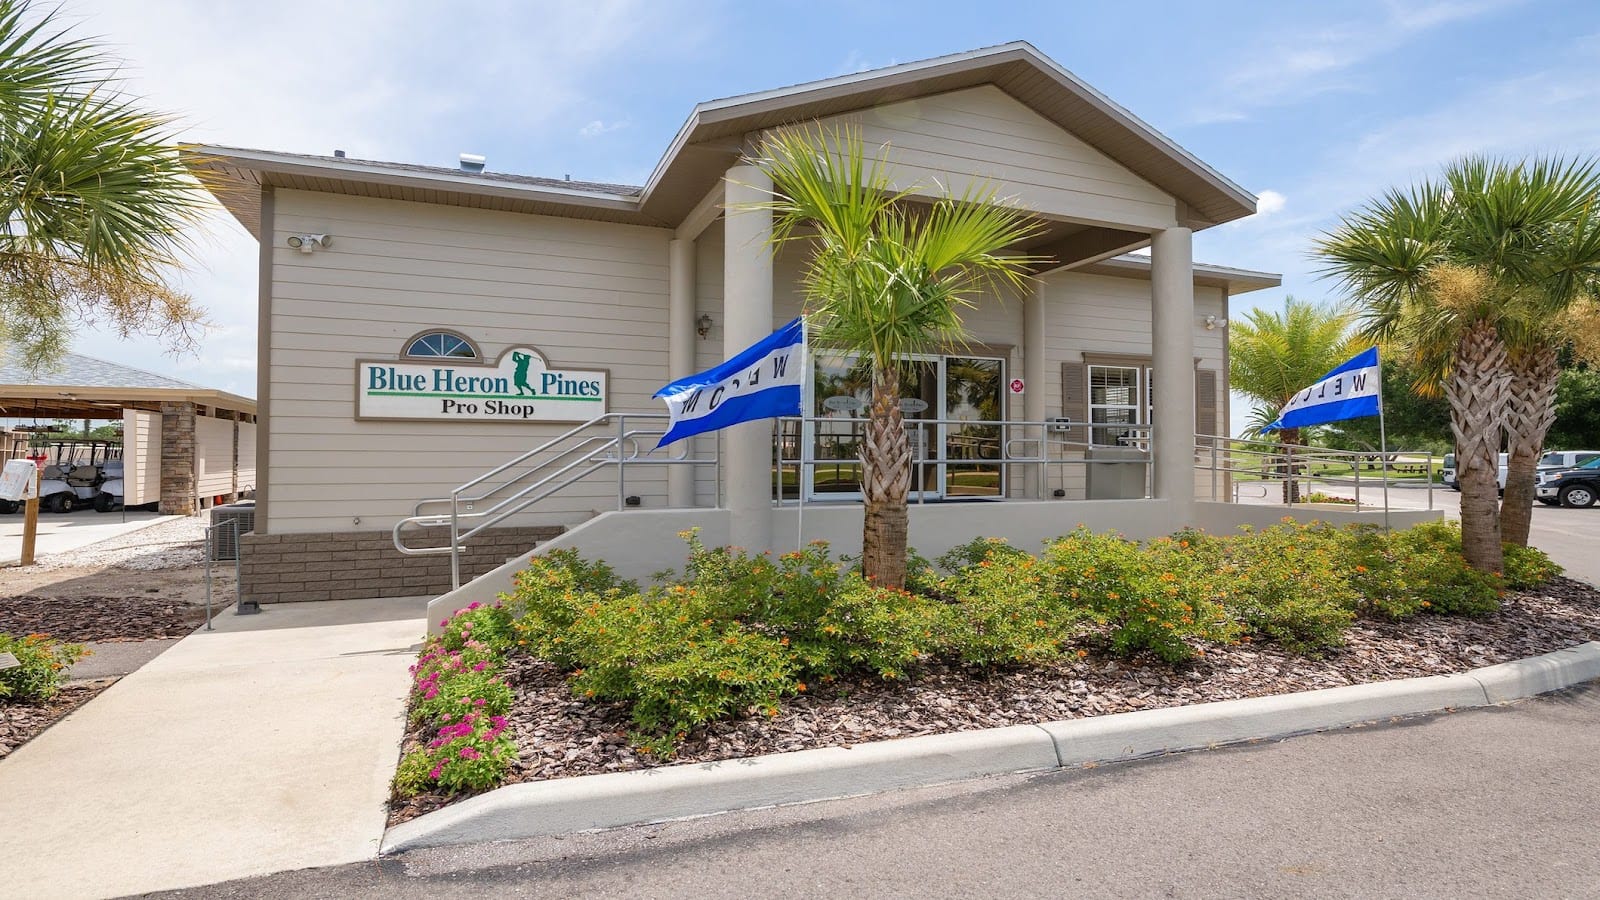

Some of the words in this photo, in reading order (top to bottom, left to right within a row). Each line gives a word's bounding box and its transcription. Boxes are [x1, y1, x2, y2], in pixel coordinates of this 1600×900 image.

[368, 366, 426, 391] Blue
[432, 369, 509, 394] Heron
[540, 373, 600, 396] Pines
[442, 399, 478, 415] Pro
[484, 400, 534, 418] Shop
